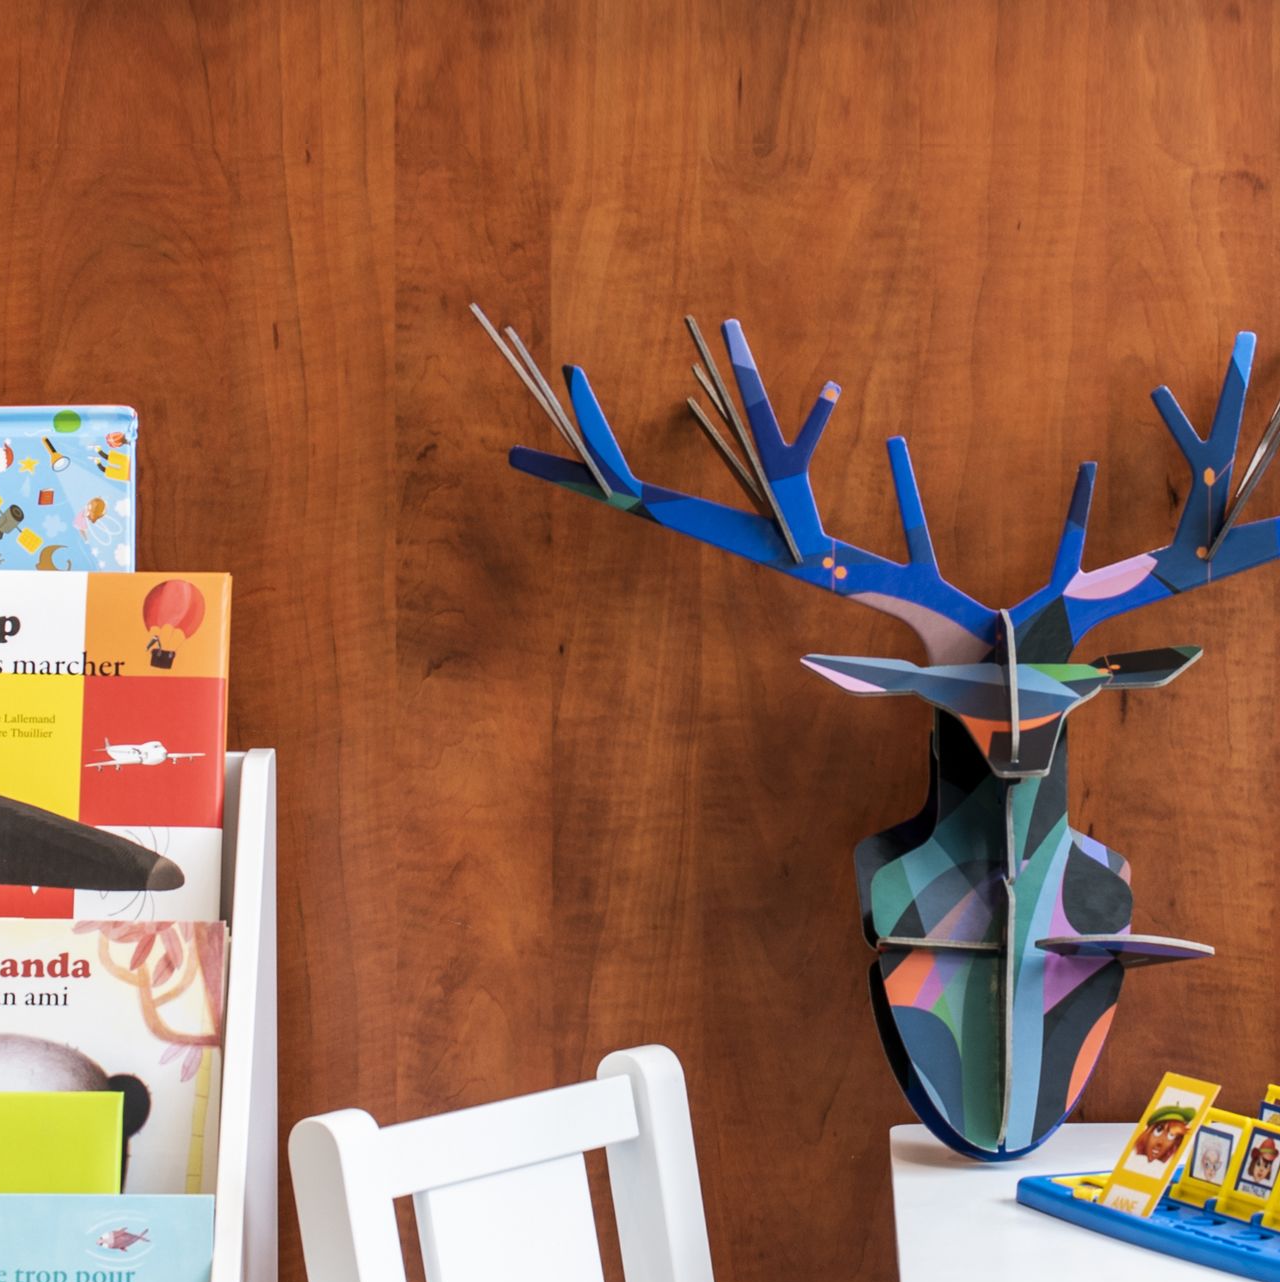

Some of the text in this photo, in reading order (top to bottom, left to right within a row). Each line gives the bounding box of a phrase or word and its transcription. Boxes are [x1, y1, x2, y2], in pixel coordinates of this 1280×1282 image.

[12, 652, 125, 677] marcher
[4, 713, 56, 724] Lallemand
[11, 727, 53, 738] Thuillier
[24, 986, 69, 1007] ami
